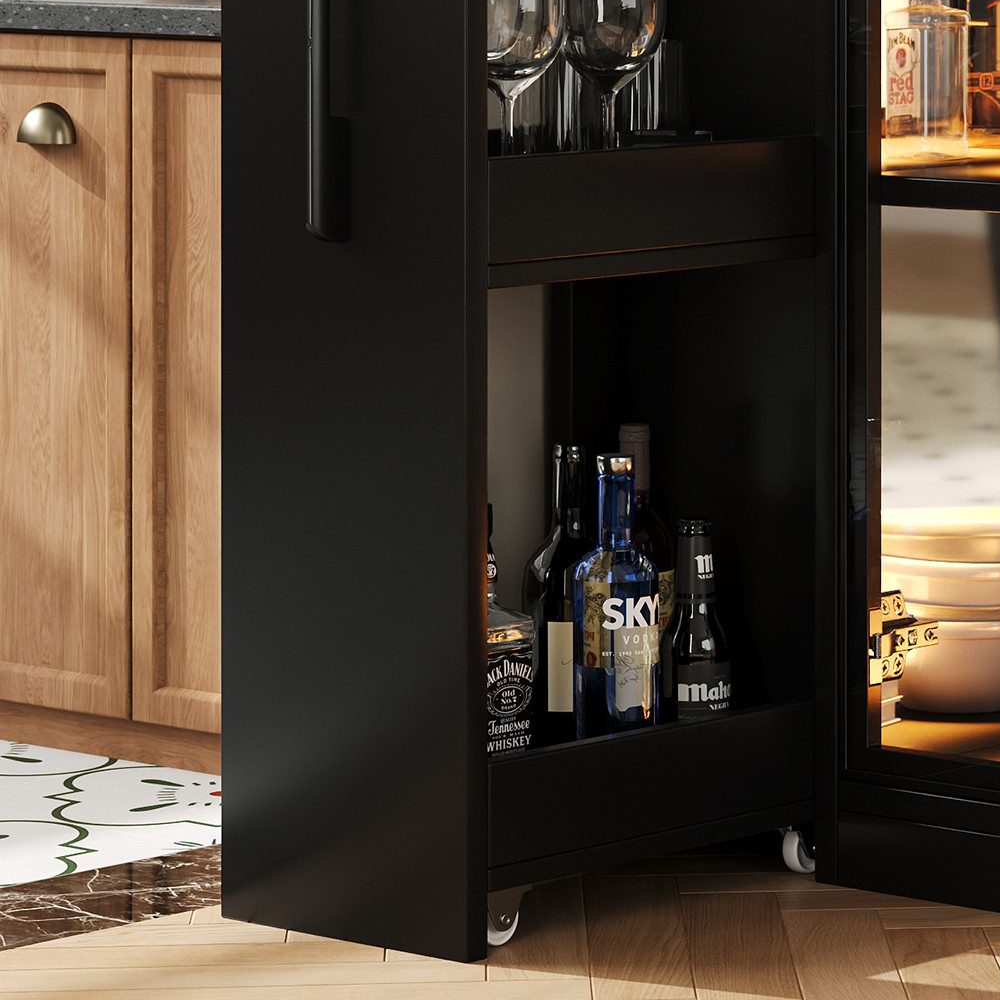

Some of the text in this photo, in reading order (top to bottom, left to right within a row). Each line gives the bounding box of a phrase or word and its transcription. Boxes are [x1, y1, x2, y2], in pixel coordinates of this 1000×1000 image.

[889, 70, 915, 92] red
[888, 91, 915, 105] STAG
[487, 665, 504, 688] ACK
[496, 678, 507, 687] OLD
[501, 689, 516, 698] Old
[487, 719, 530, 736] Tennessee
[487, 734, 532, 753] WHISKEY
